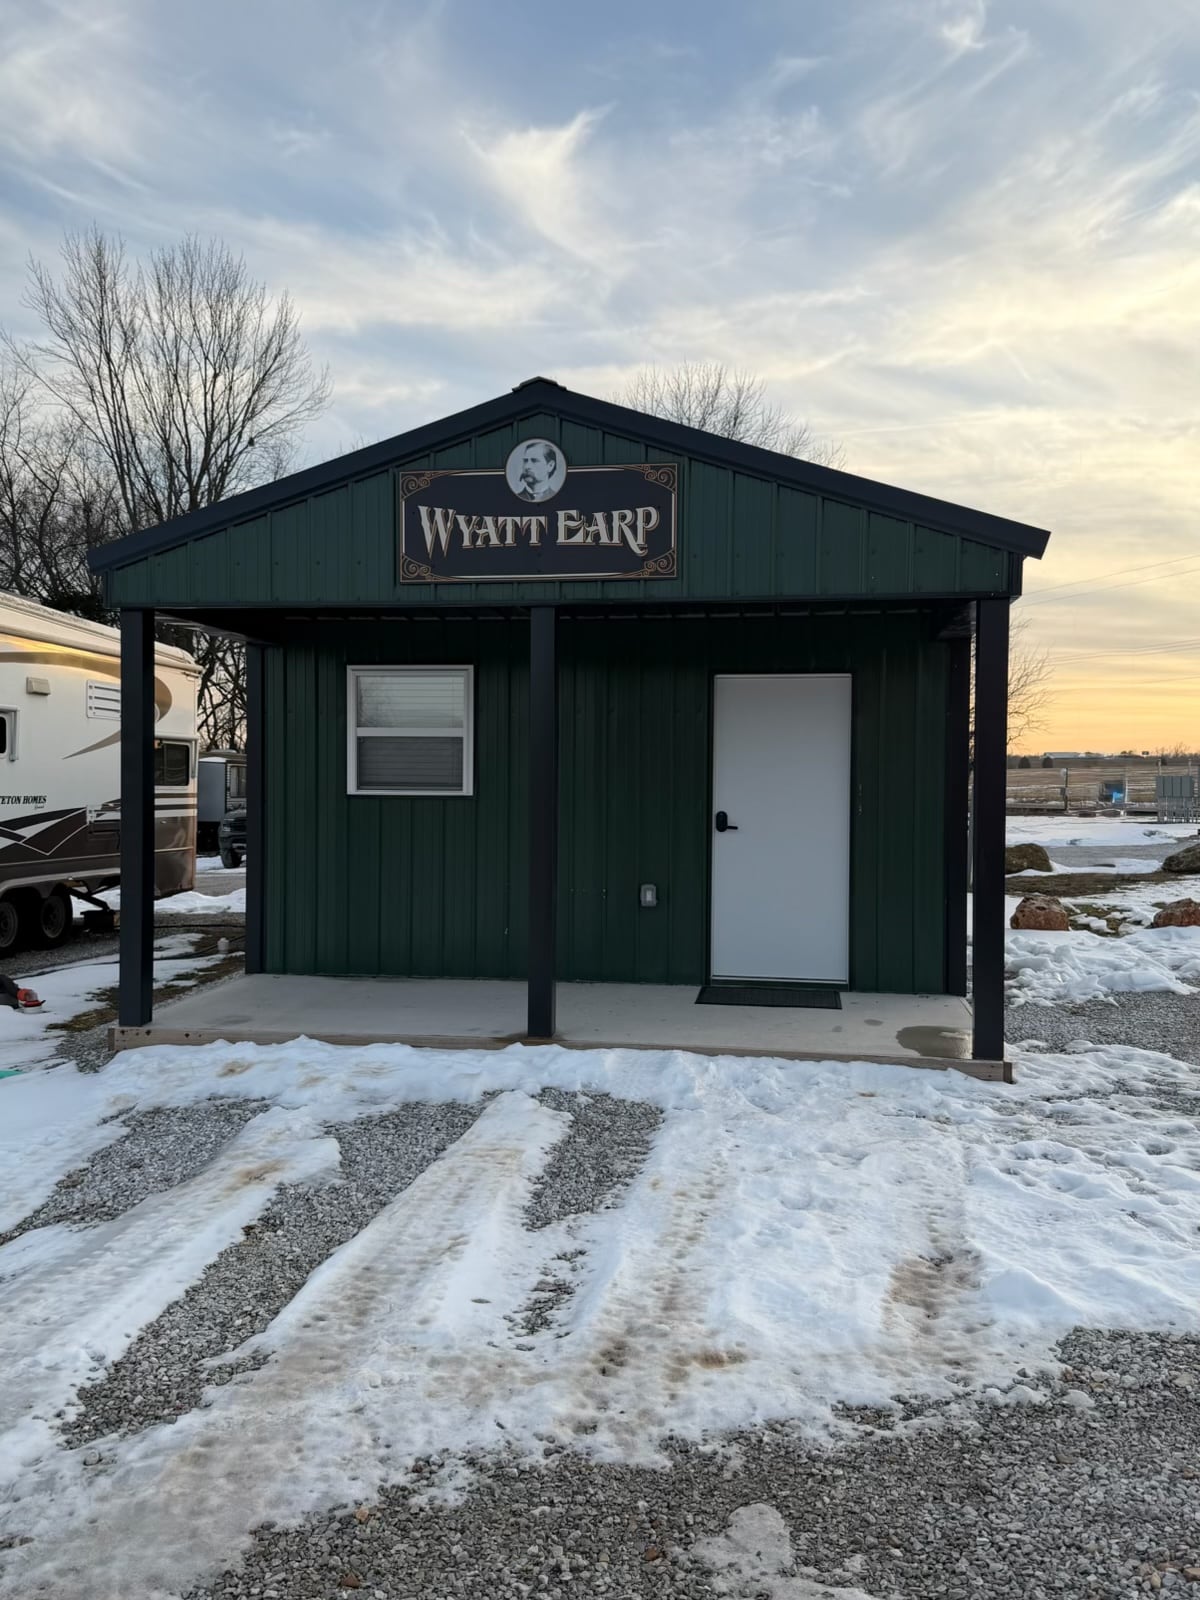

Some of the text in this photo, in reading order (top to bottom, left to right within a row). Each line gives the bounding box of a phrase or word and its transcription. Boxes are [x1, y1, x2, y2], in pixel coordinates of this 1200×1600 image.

[418, 505, 660, 559] WYATT EARP
[22, 795, 47, 804] HOMES
